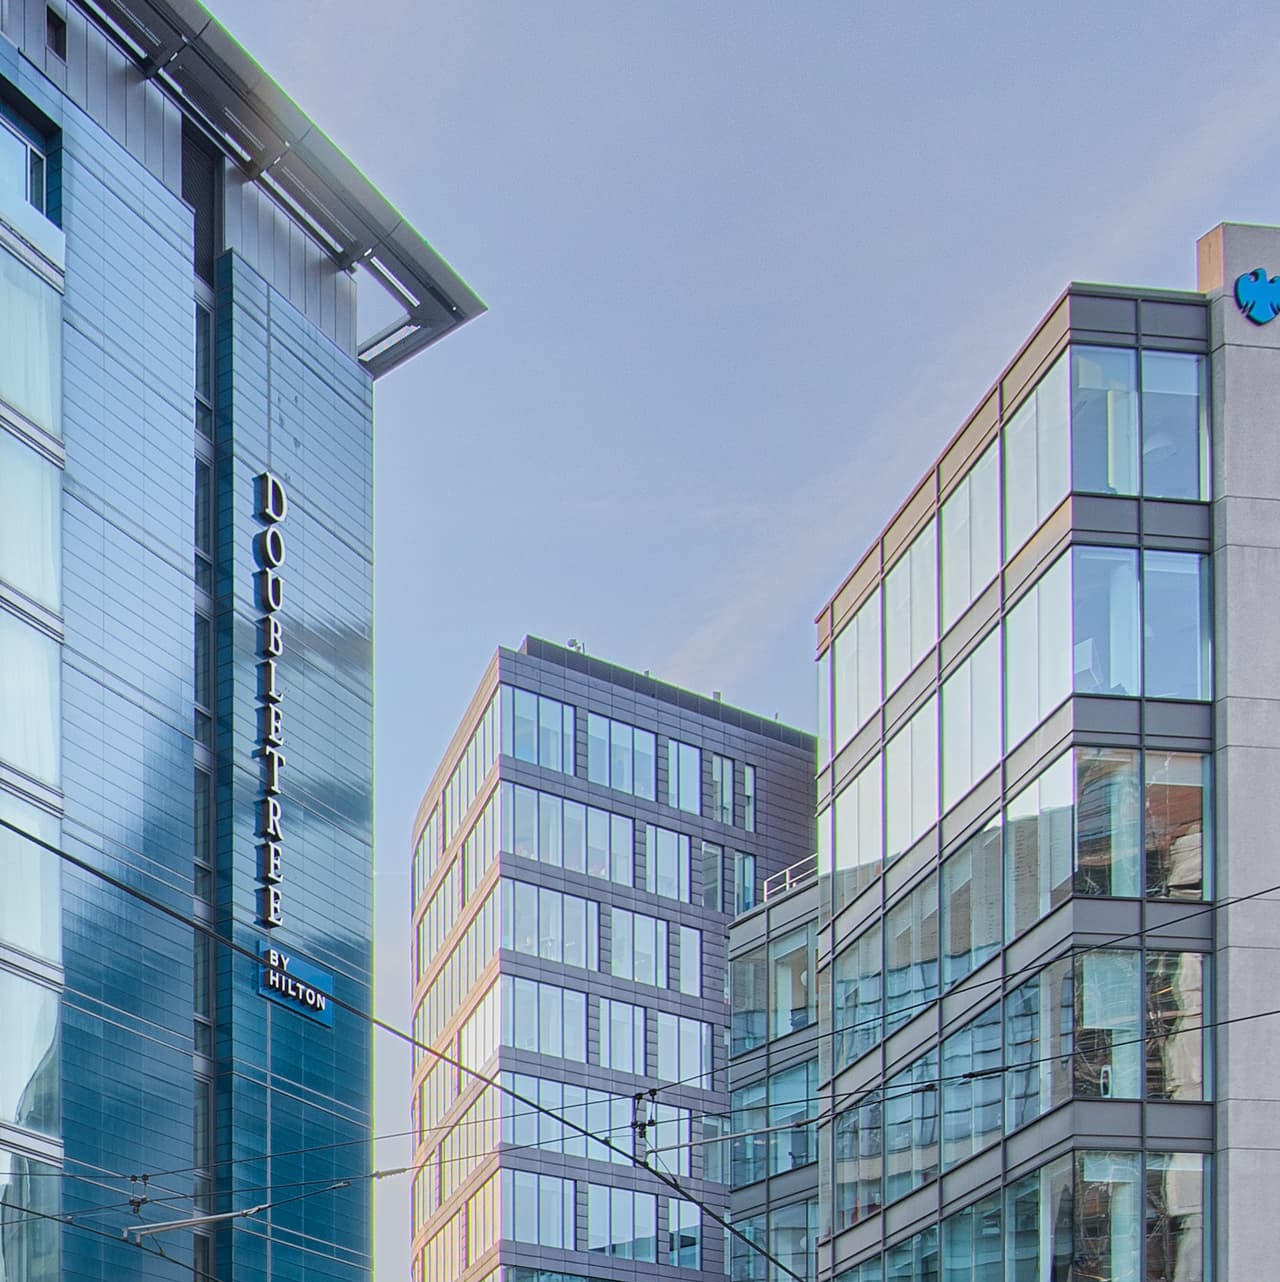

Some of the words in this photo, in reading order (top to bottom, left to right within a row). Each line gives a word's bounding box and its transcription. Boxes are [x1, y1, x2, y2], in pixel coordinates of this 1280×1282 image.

[262, 471, 287, 926] DOUBLETREE
[269, 949, 290, 971] BY
[269, 969, 326, 1011] HILTON
